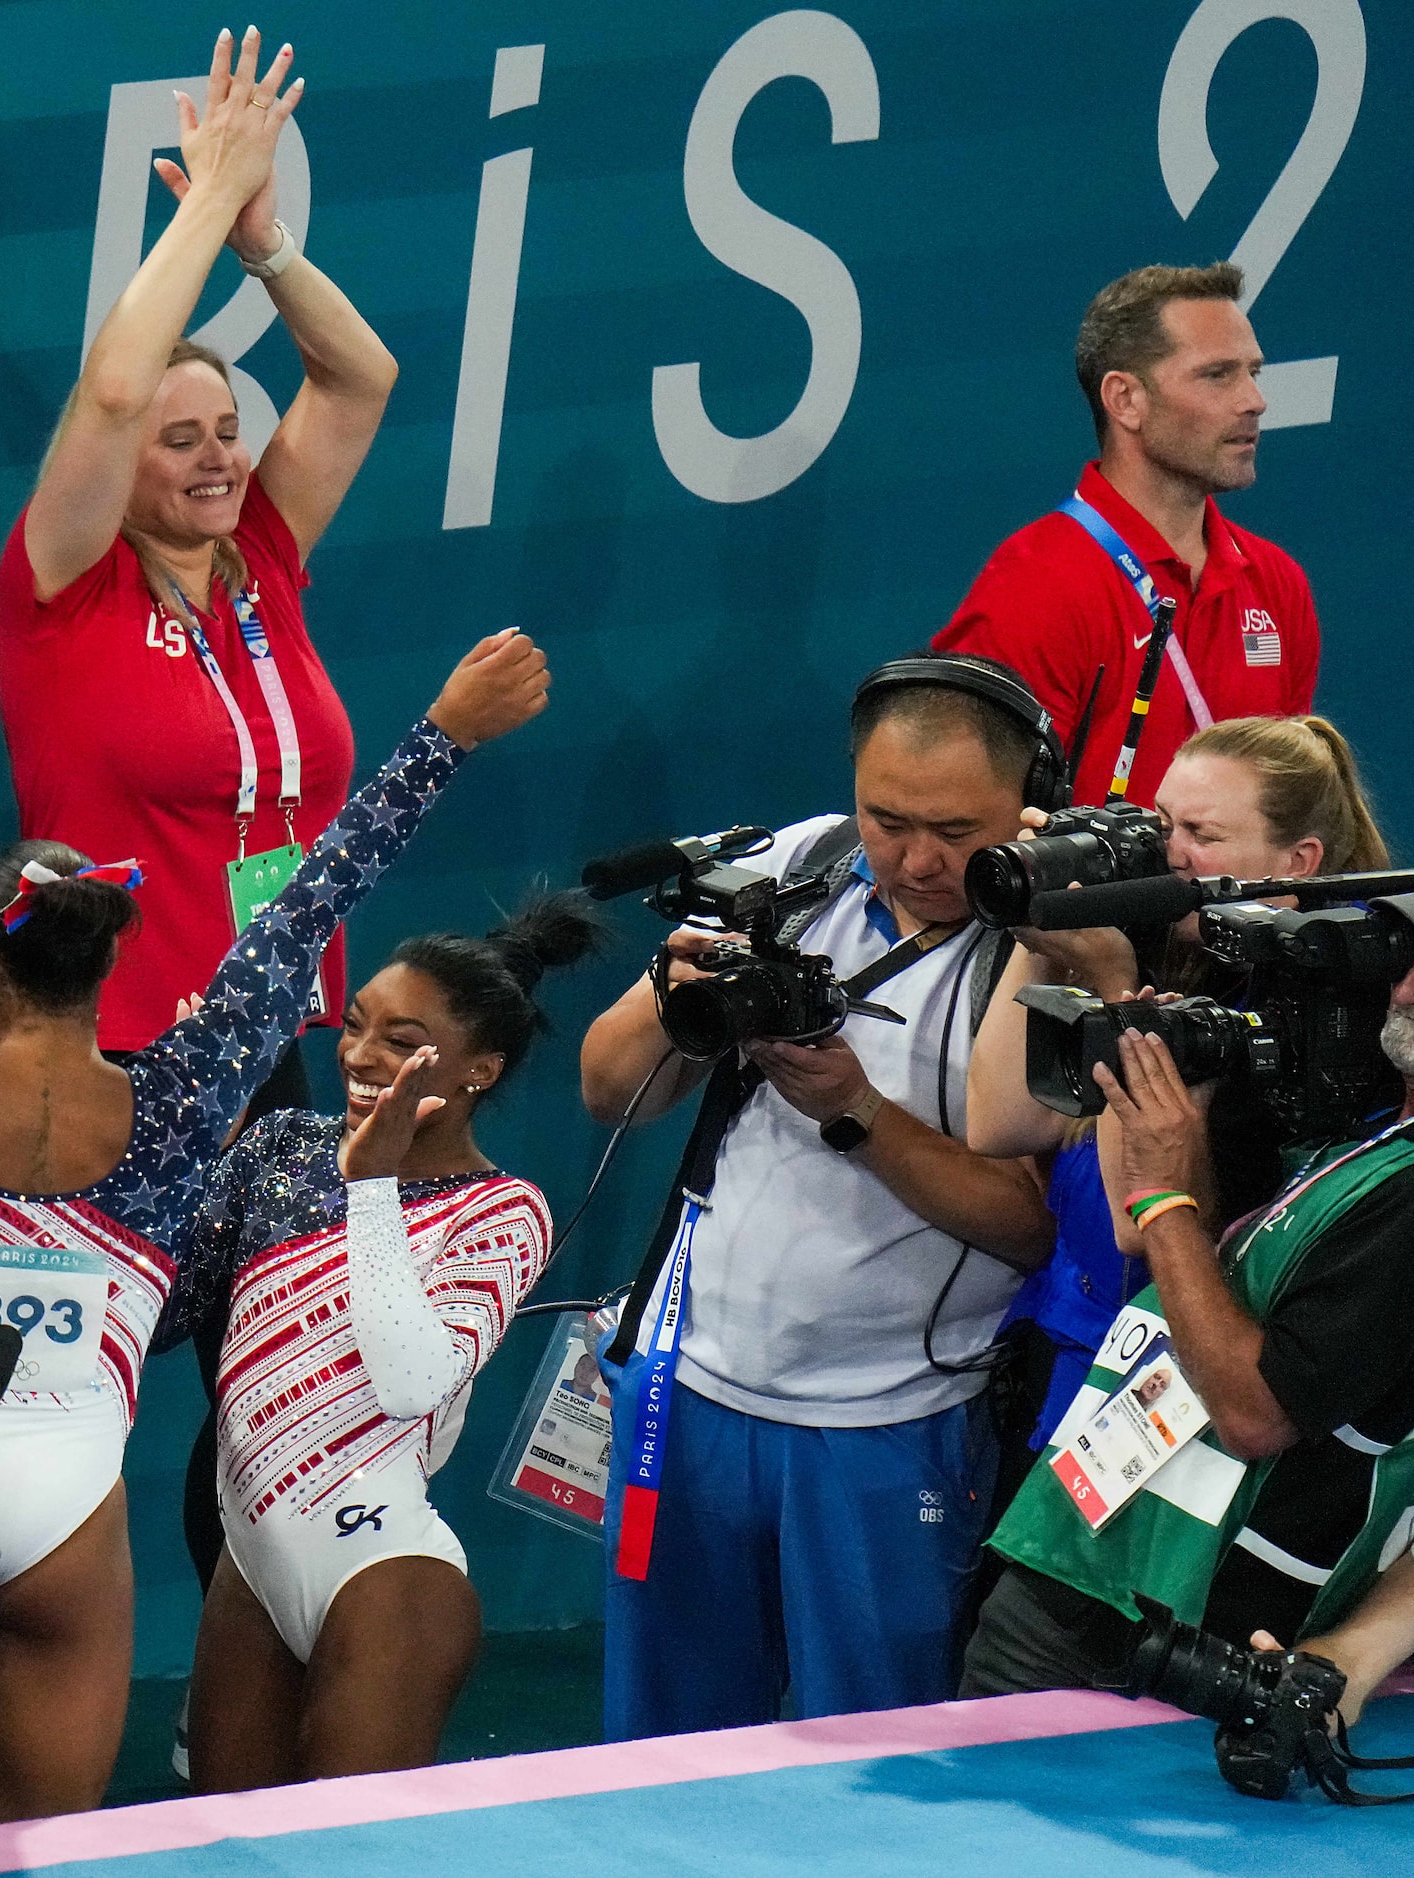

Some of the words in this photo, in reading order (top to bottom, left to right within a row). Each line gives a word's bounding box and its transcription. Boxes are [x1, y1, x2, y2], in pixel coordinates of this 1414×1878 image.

[40, 1254, 80, 1267] 2024
[647, 1361, 666, 1413] 2024
[919, 1507, 945, 1523] OBS
